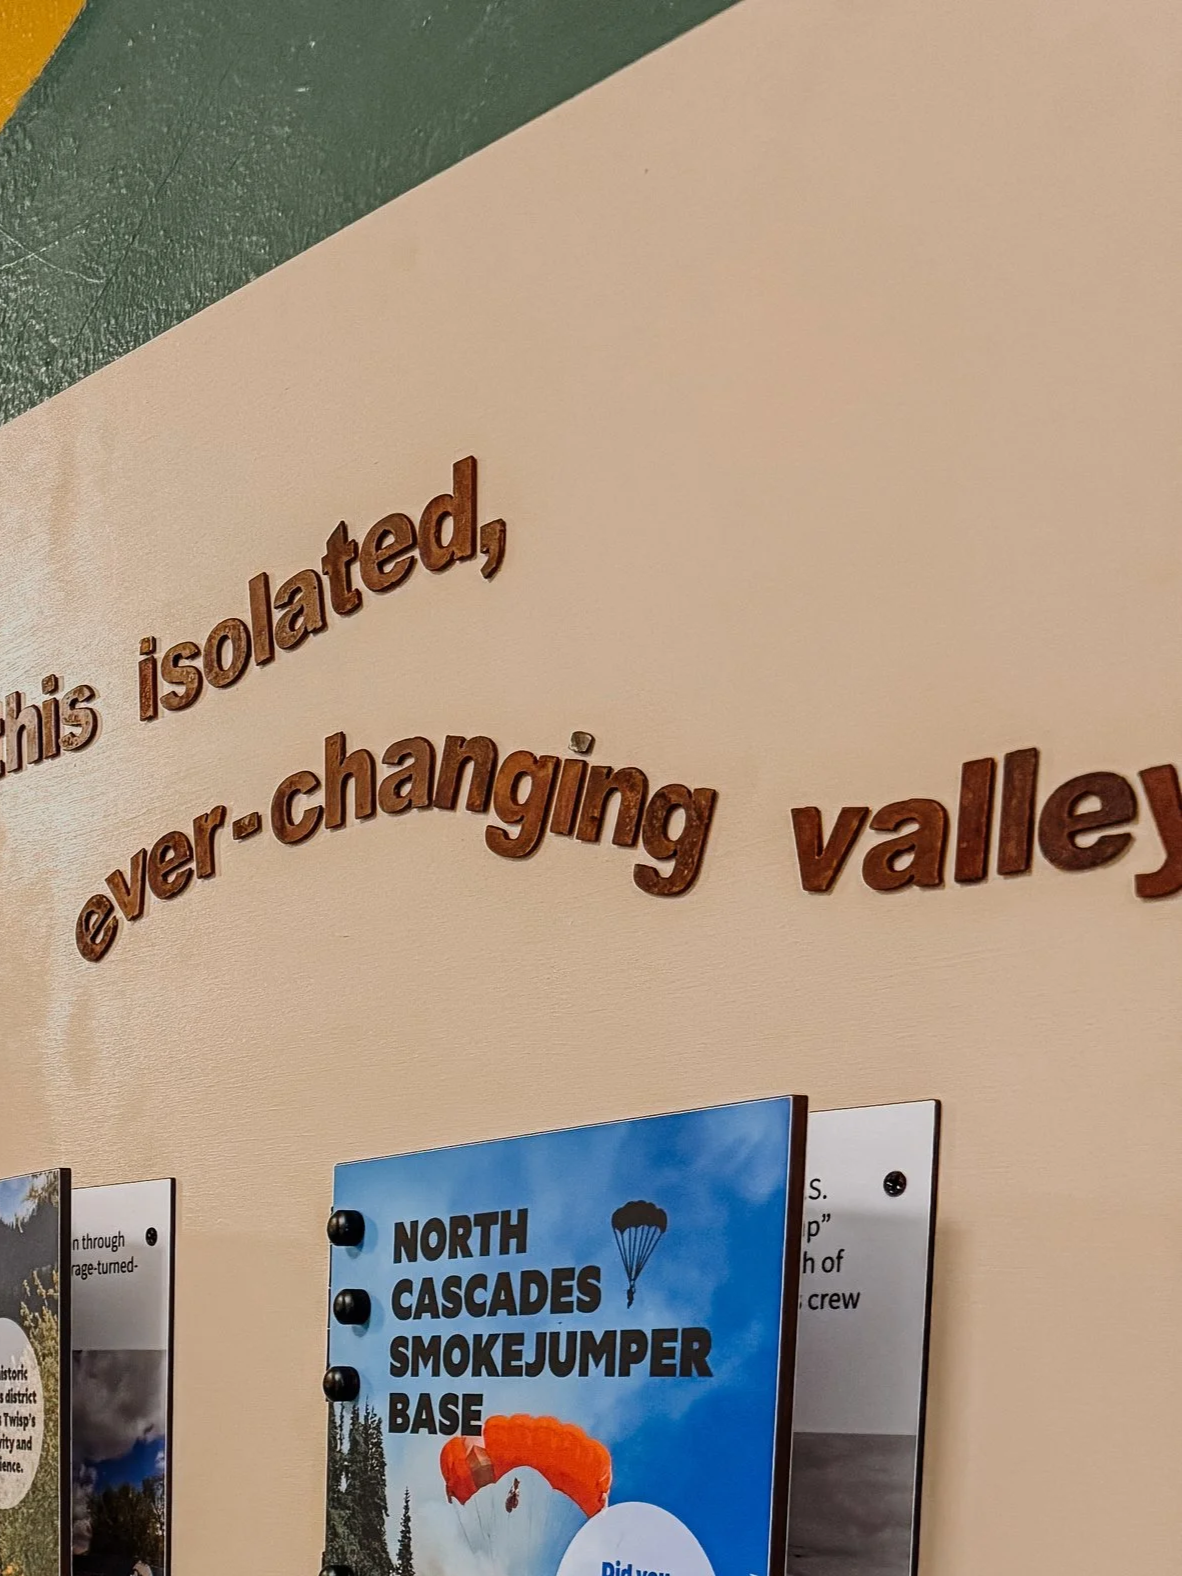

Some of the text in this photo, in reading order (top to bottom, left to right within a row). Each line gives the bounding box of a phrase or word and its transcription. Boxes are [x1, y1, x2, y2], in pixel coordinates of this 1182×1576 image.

[138, 455, 508, 723] isolated,
[75, 730, 719, 962] ever-changing
[81, 1230, 125, 1252] through
[393, 1207, 529, 1264] NORTH
[821, 1248, 845, 1273] of
[391, 1264, 602, 1321] CASCADES
[807, 1291, 861, 1310] crew
[389, 1326, 714, 1378] SMOKEJUMPER
[4, 1387, 37, 1405] district
[3, 1411, 36, 1431] Twisp's
[387, 1392, 484, 1437] BASE
[16, 1435, 33, 1451] and
